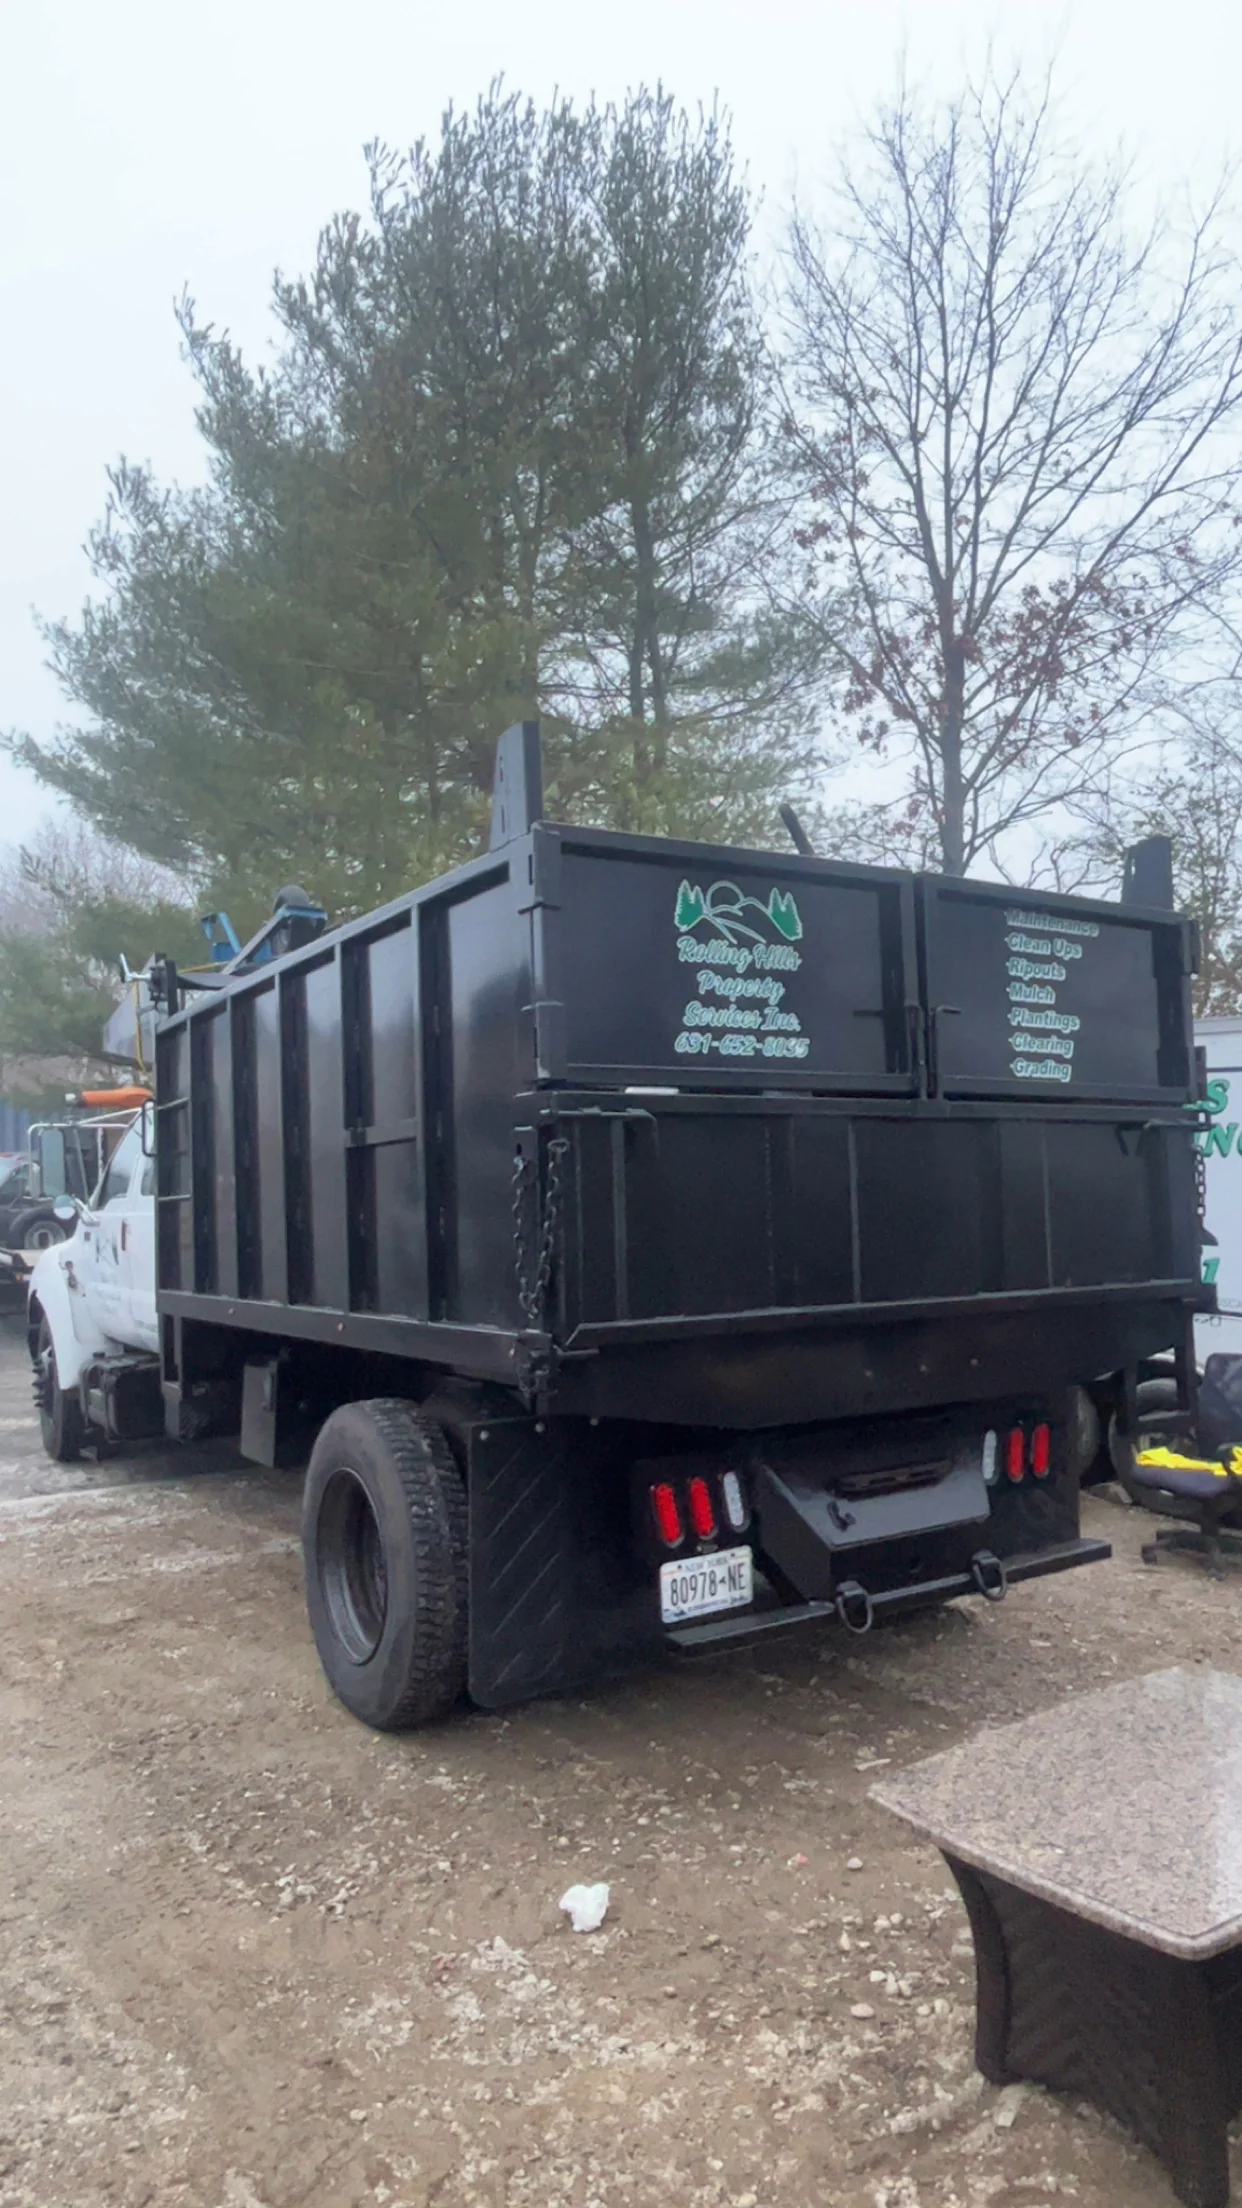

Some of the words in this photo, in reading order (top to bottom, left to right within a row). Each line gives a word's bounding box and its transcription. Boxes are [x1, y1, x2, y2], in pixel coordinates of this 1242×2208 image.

[1005, 908, 1100, 937] Maintenance
[676, 935, 752, 974] Rolling
[752, 942, 802, 971] Hills
[1006, 932, 1052, 955] Clean
[1052, 938, 1083, 960] Ups
[1007, 956, 1067, 981] Ripouts
[696, 969, 786, 1005] Property
[1008, 981, 1056, 1005] Mulch
[683, 1000, 762, 1029] Services
[760, 1006, 802, 1032] Inc.
[1010, 1007, 1080, 1033] Plantings
[1011, 1032, 1074, 1059] Clearing
[1012, 1057, 1072, 1083] Grading
